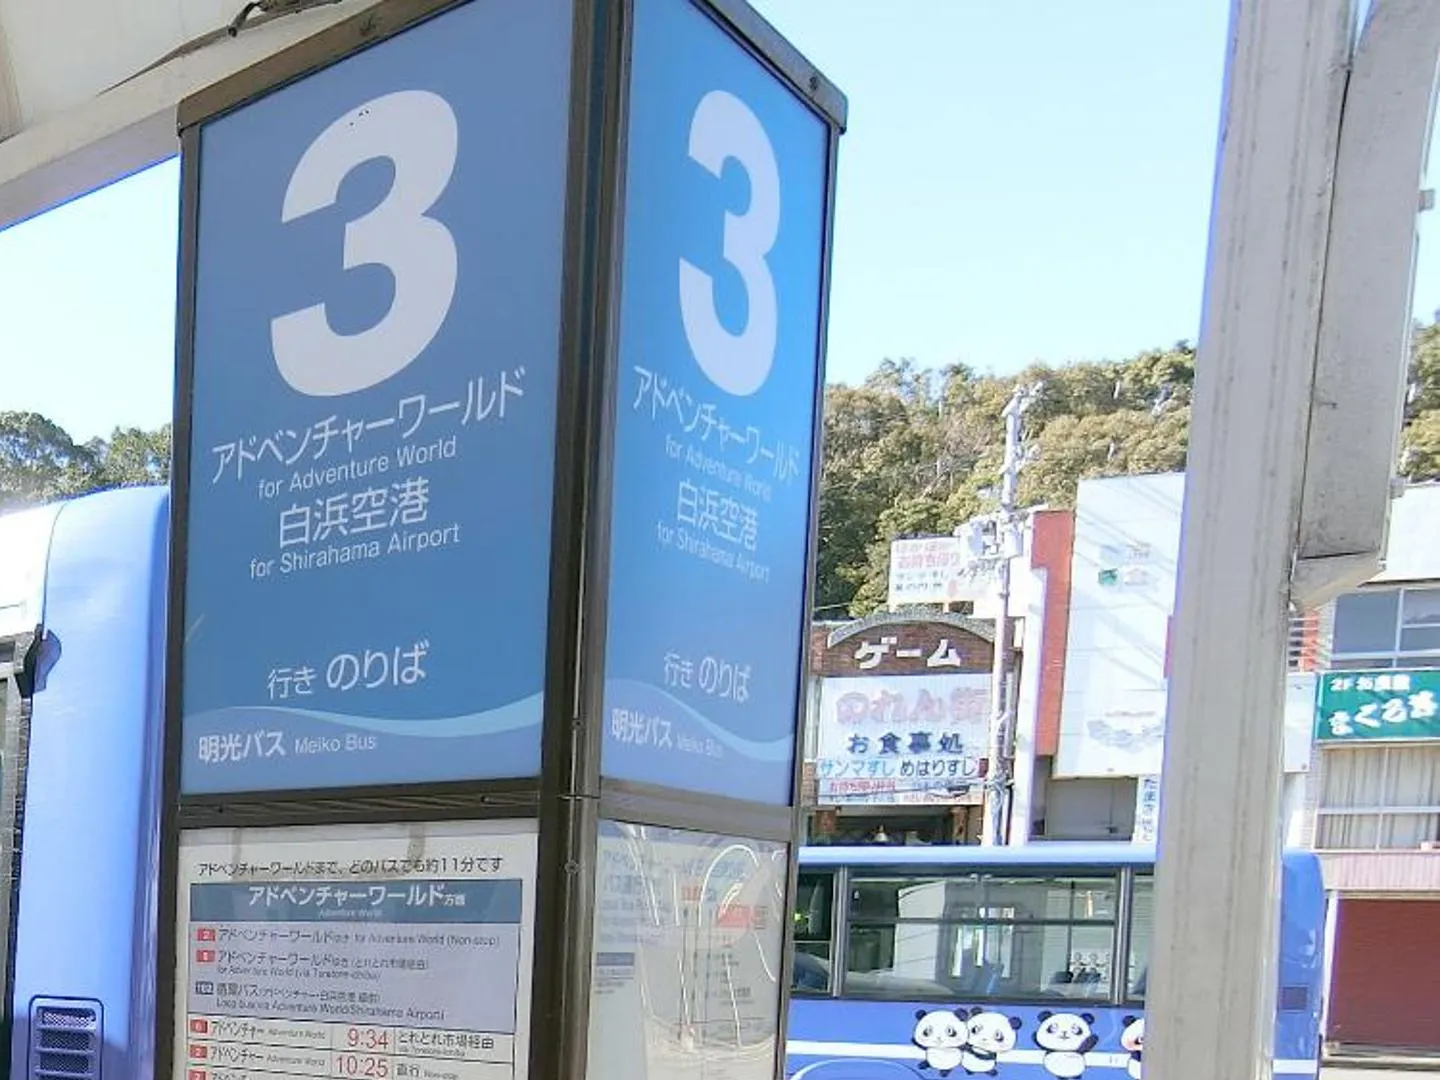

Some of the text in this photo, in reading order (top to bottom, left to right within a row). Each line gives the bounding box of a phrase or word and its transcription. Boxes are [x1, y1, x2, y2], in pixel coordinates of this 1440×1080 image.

[270, 90, 459, 396] 3
[679, 90, 781, 396] 3
[212, 366, 526, 485] アドベンチャーワールド
[633, 365, 800, 481] アドベンチャーワールド
[258, 436, 458, 500] for Adventure World
[279, 475, 430, 549] 白浜空港
[677, 478, 758, 552] 白浜空港
[249, 523, 462, 579] for Shirahama Airport
[656, 520, 674, 543] for
[676, 528, 735, 567] Shirahama
[267, 641, 431, 700] 行き のりば
[663, 651, 752, 704] 行き のりば
[854, 636, 962, 670] ゲーム
[198, 728, 377, 763] 明光バス Meiko Bus
[611, 708, 673, 750] 明光バス
[847, 731, 964, 755] お食事処
[336, 1055, 389, 1078] 10:25
[347, 1028, 389, 1049] 9:34
